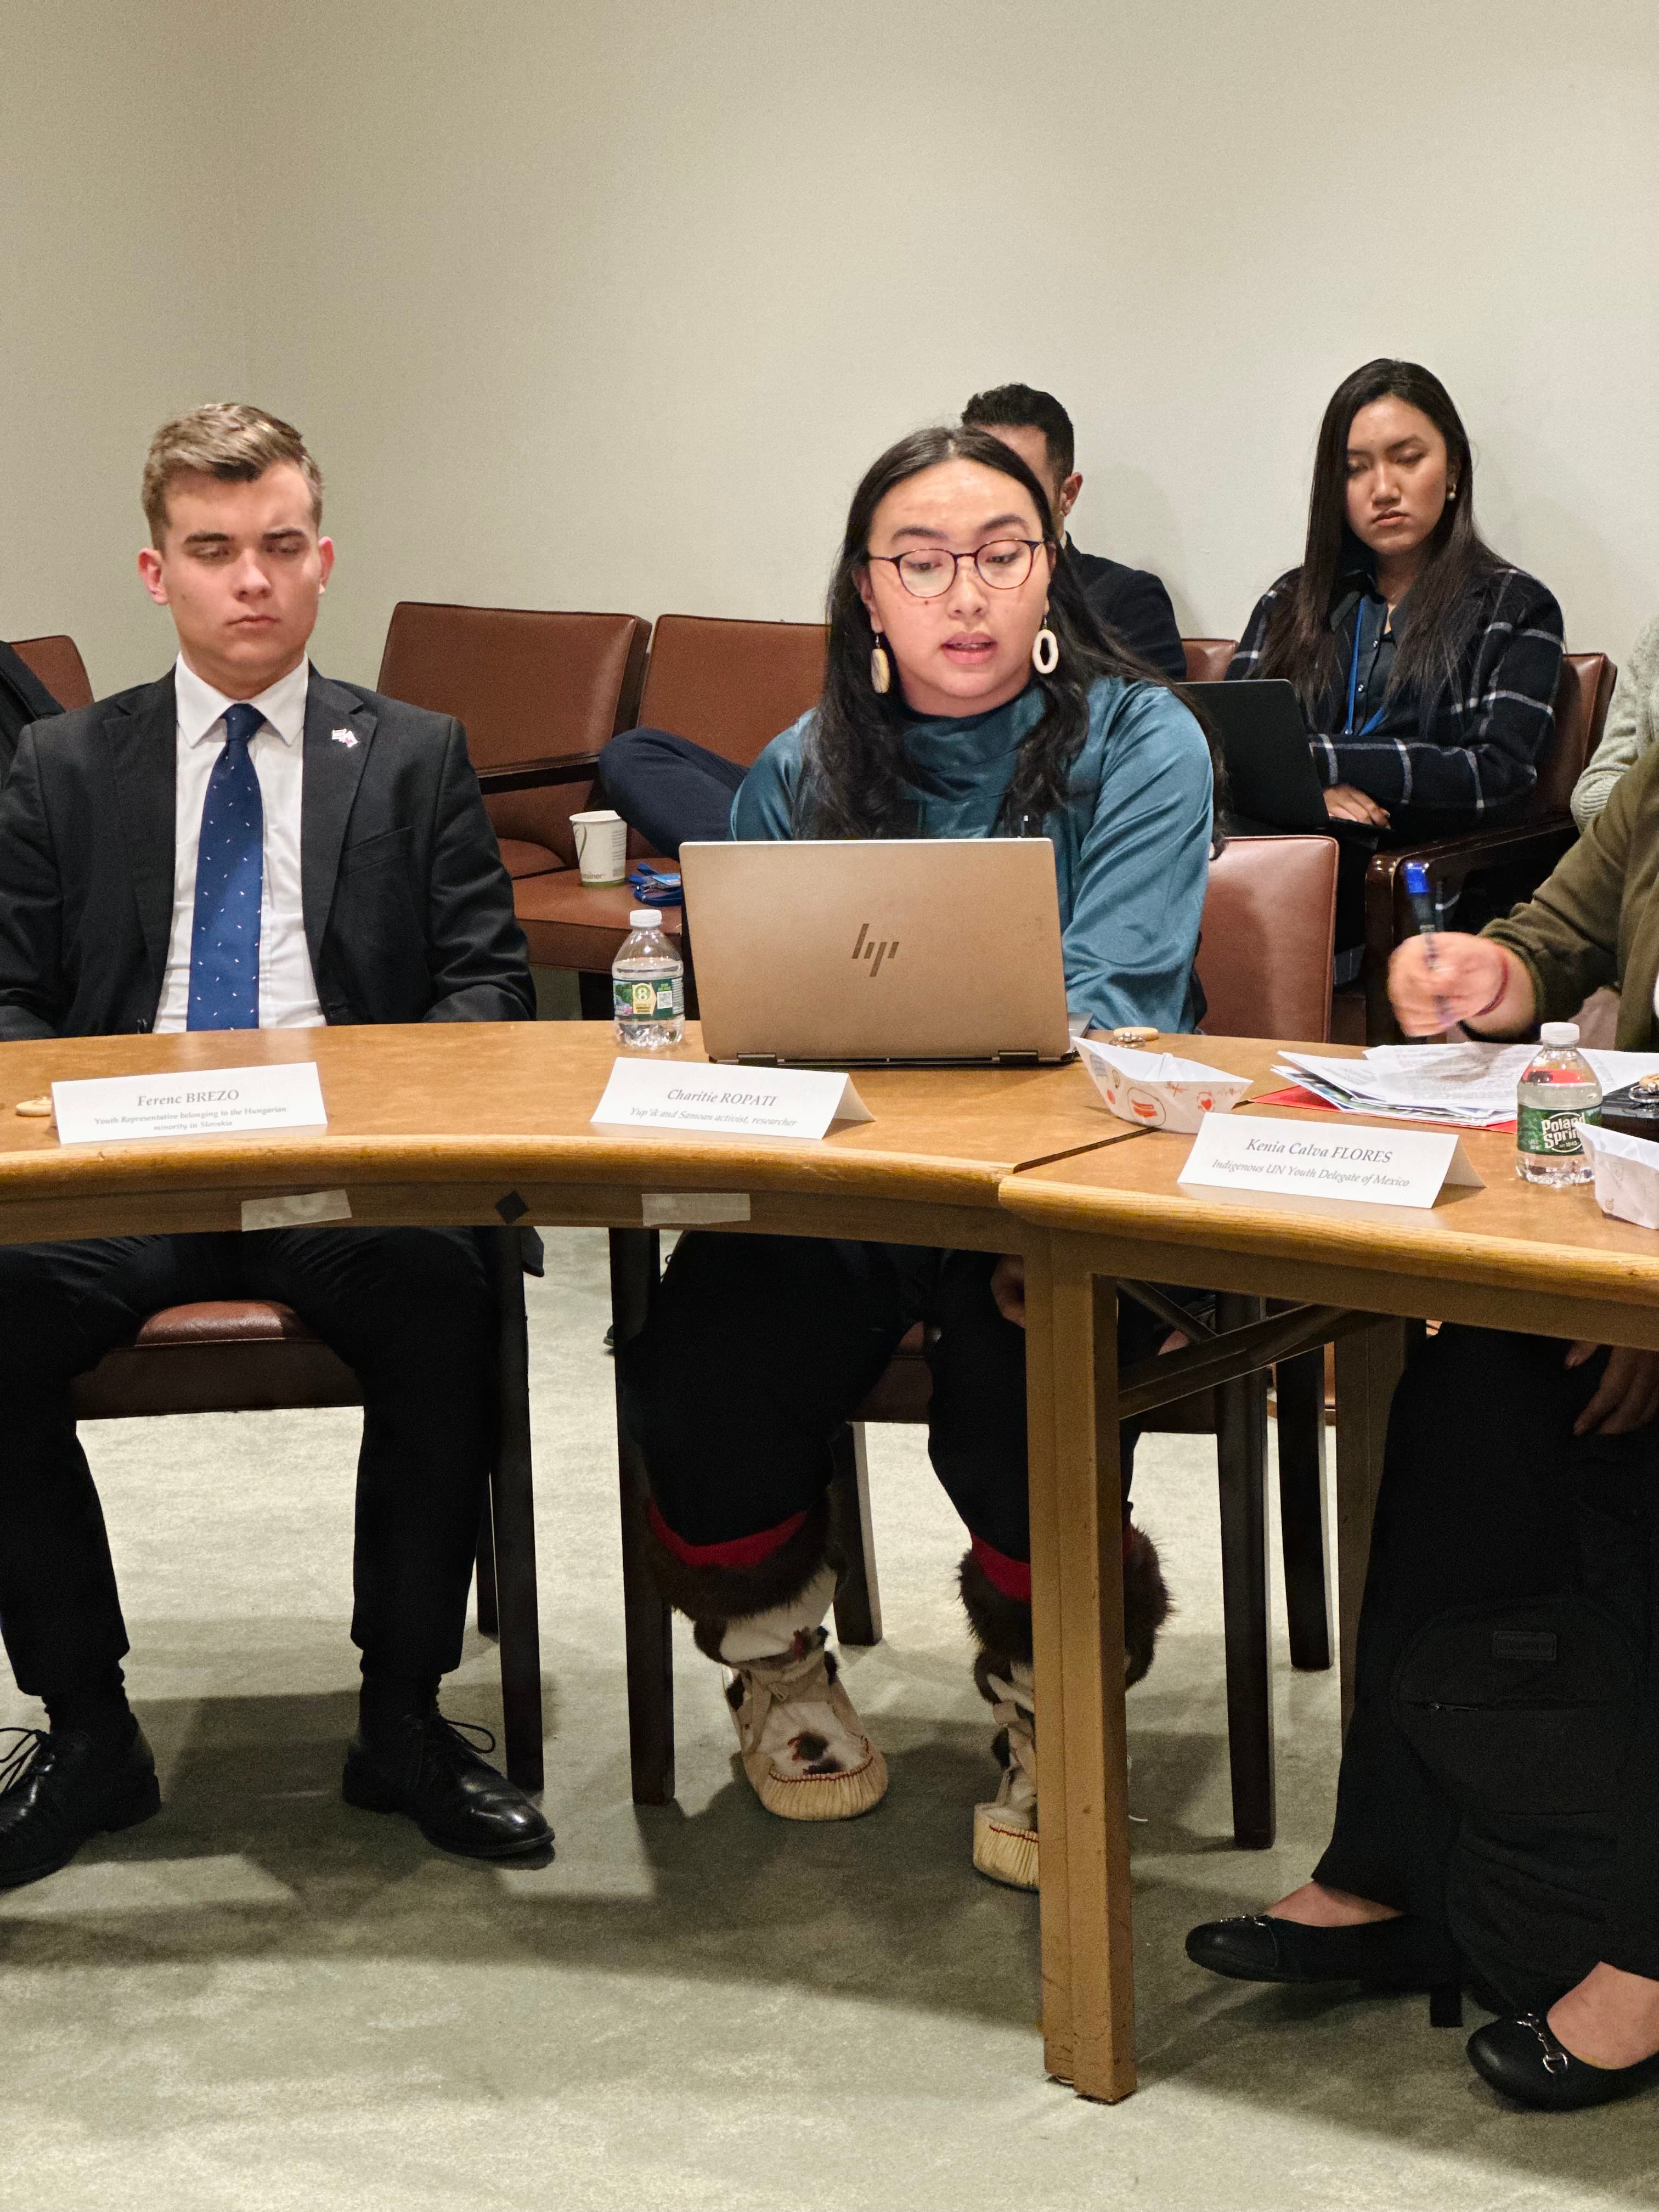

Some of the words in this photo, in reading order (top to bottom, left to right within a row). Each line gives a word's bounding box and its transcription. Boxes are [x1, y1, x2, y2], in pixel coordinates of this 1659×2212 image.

[851, 923, 899, 977] hp
[137, 1096, 182, 1107] Ferenc
[186, 1090, 239, 1103] BREZO
[667, 1089, 718, 1103] Charitie
[720, 1093, 777, 1107] ROPATI
[121, 1114, 178, 1124] Representative
[180, 1111, 218, 1120] belonging
[244, 1106, 287, 1116] Hungarian
[660, 1110, 678, 1119] and
[678, 1110, 713, 1121] Samoan
[715, 1114, 749, 1124] activist,
[752, 1117, 798, 1127] researcher
[1541, 1112, 1585, 1135] Poland
[153, 1123, 187, 1131] minority
[1543, 1128, 1579, 1149] Sprin
[1246, 1139, 1285, 1153] Kenia
[1289, 1143, 1328, 1157] Calva
[1331, 1147, 1393, 1164] FLORES
[1212, 1159, 1264, 1172] Indigenous
[1266, 1165, 1285, 1174] UN
[1288, 1167, 1316, 1178] Youth
[1318, 1169, 1360, 1183] Delegate
[1362, 1173, 1374, 1185] of
[1373, 1175, 1410, 1187] Mexico
